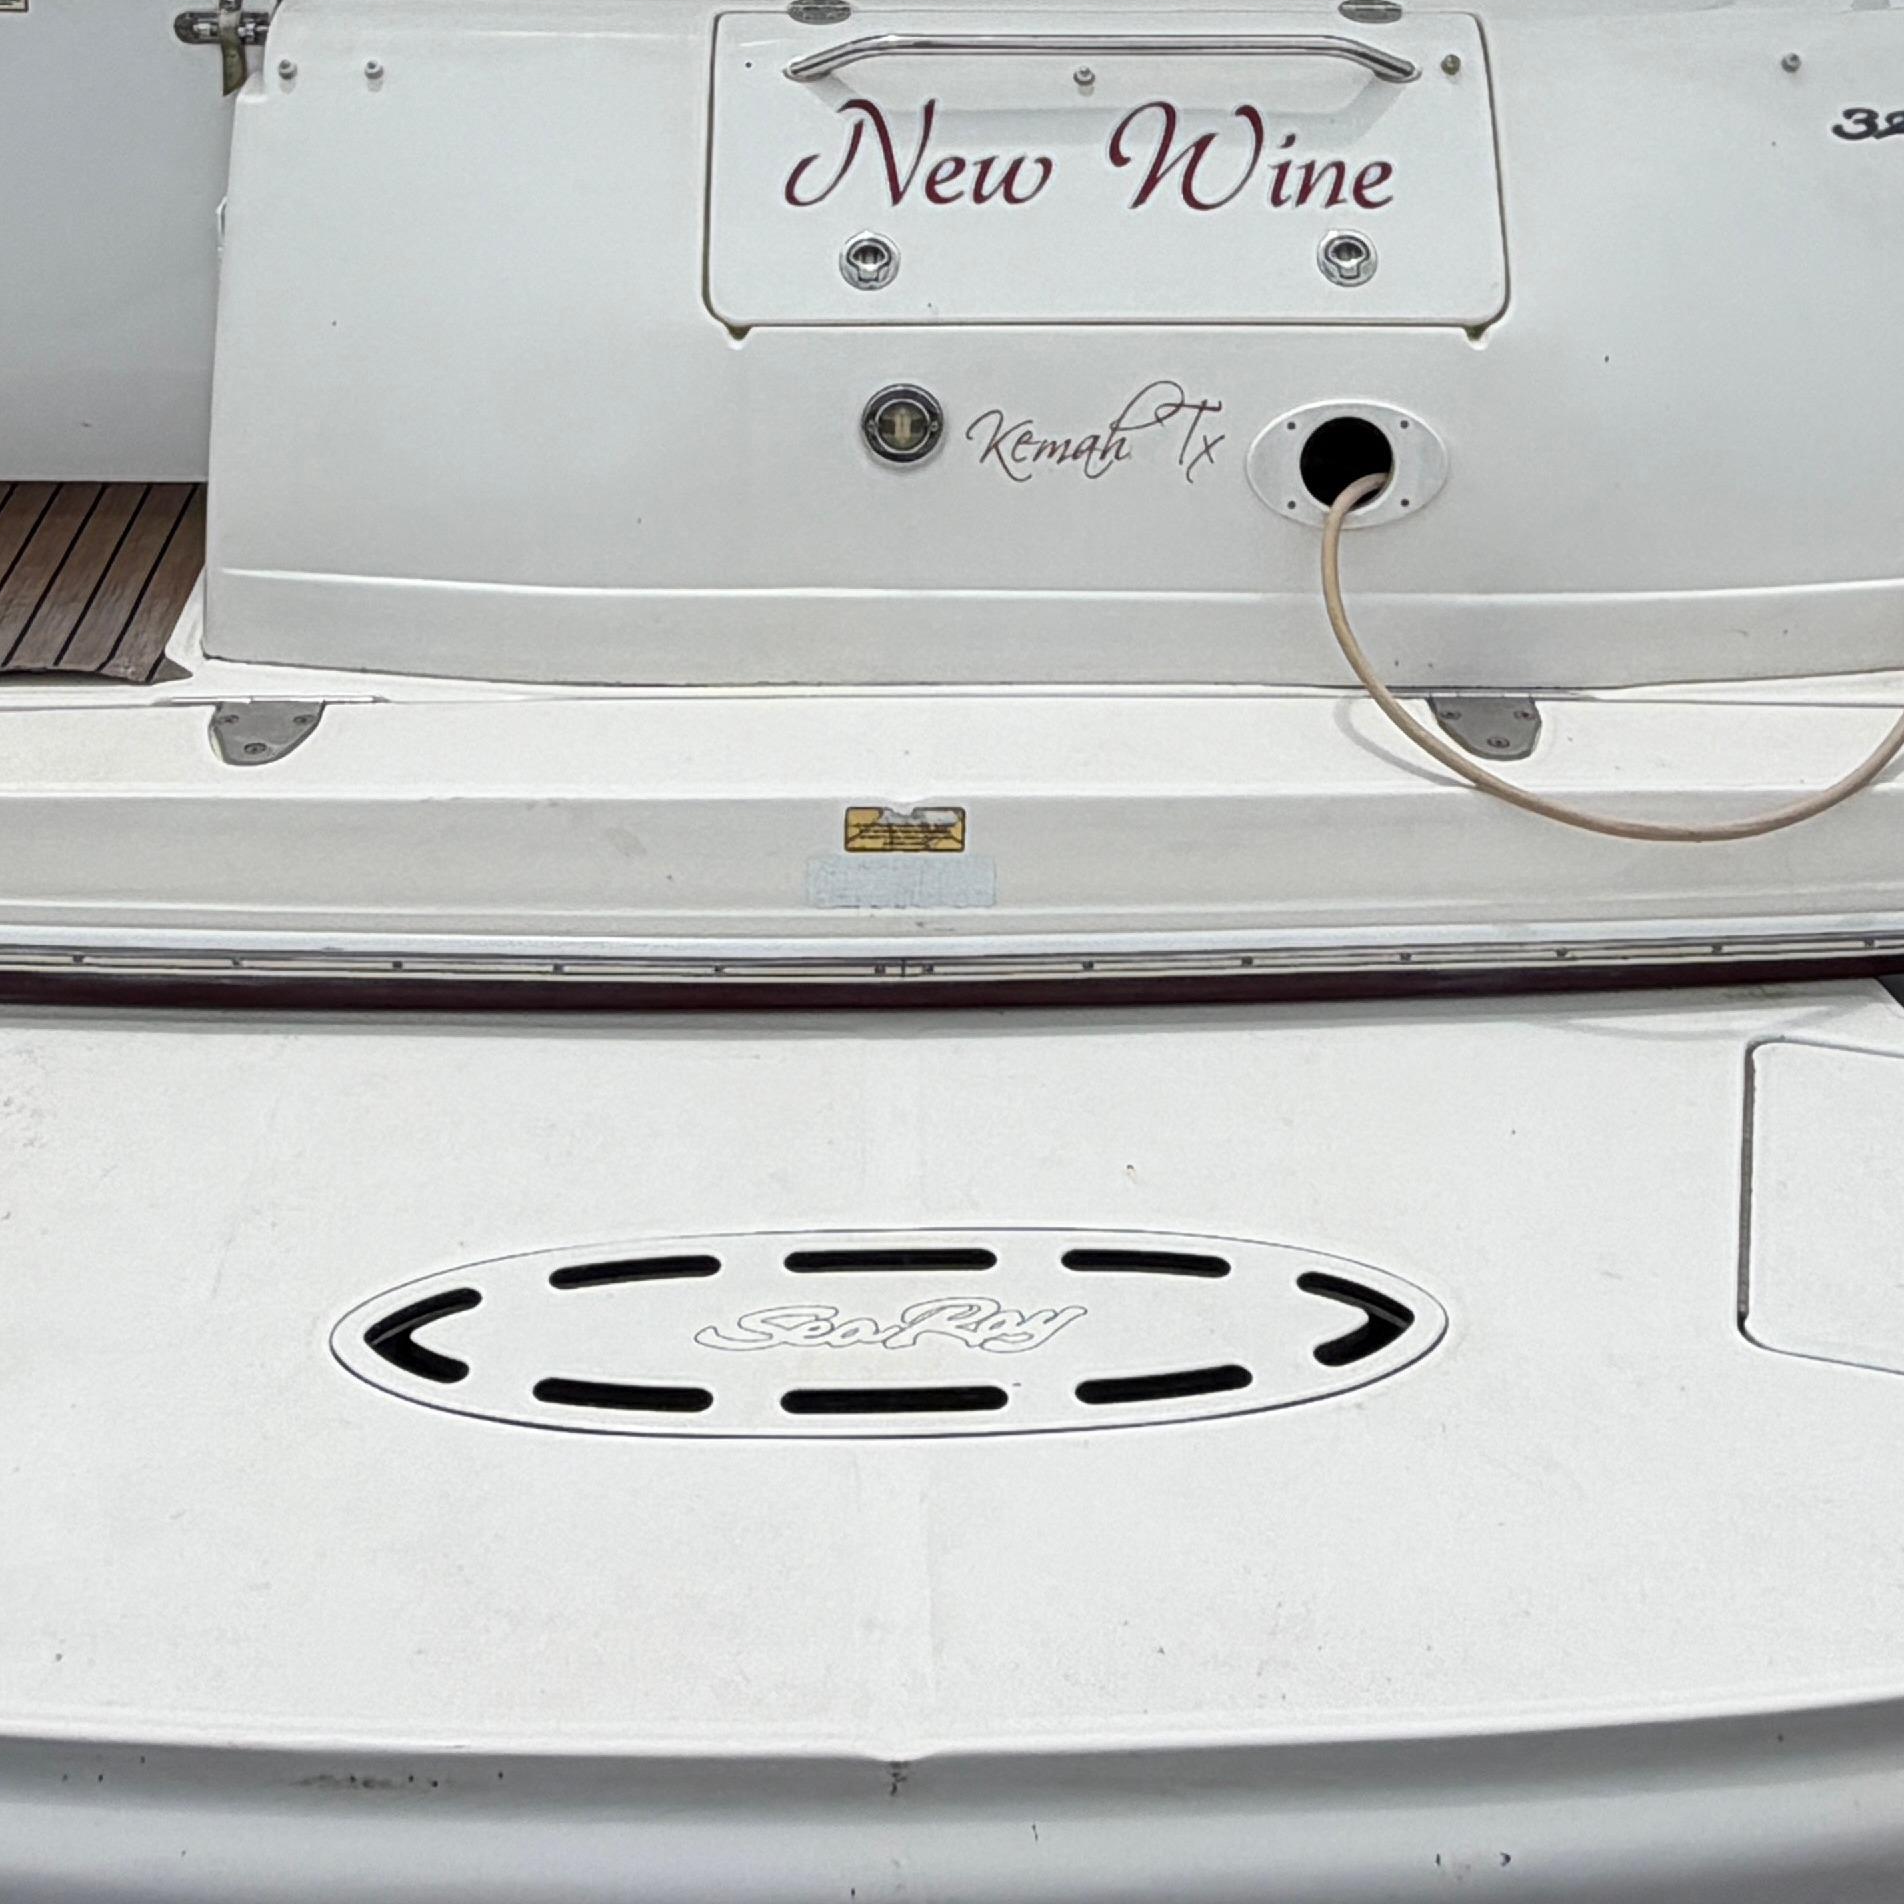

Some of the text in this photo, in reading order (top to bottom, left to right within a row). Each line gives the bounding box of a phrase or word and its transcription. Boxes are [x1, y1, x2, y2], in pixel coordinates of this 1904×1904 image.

[784, 99, 1395, 212] New Wine
[966, 380, 1184, 482] Kemah
